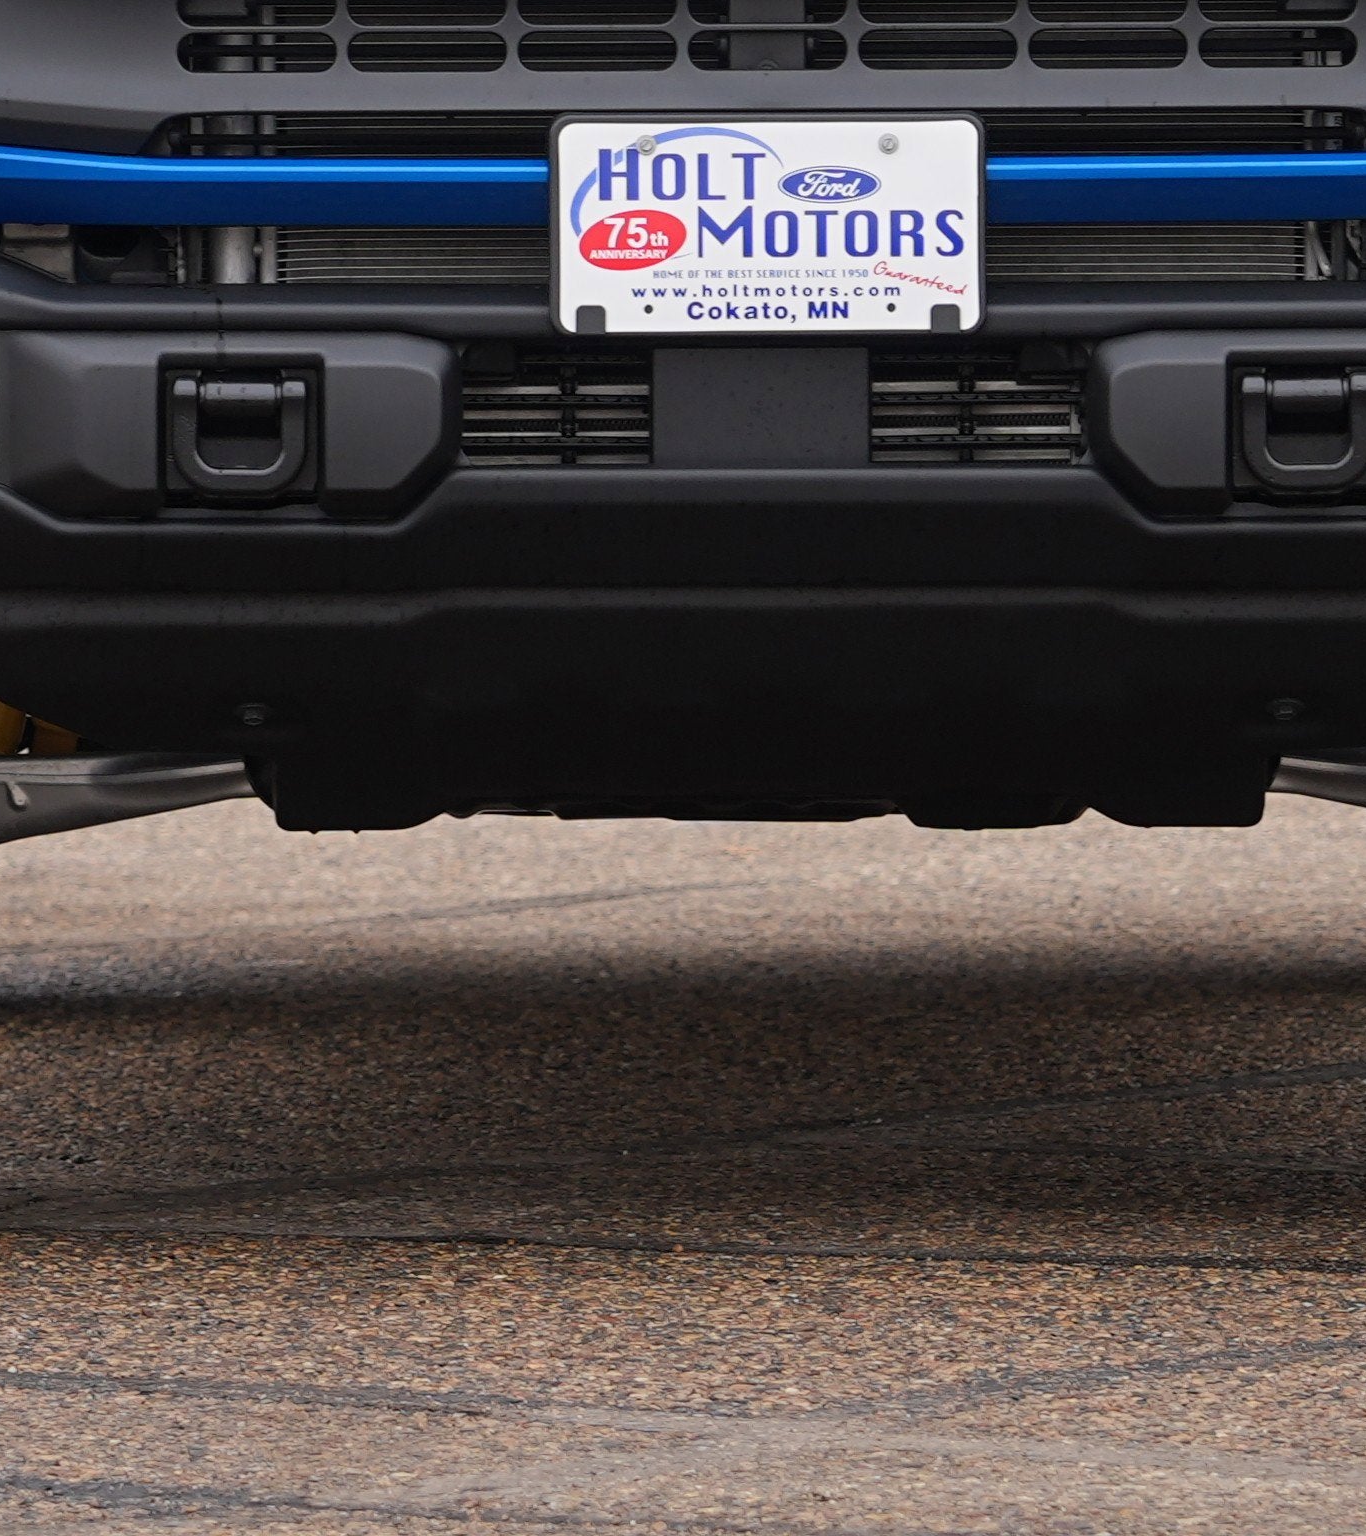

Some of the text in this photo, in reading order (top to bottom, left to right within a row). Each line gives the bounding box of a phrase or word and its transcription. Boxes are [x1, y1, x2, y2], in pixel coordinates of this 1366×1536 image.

[598, 148, 766, 201] HOLT
[797, 170, 862, 197] Ford
[603, 217, 669, 248] 75th
[697, 205, 965, 258] MOTORS
[589, 249, 669, 260] ANNIVERSARY
[653, 269, 869, 278] HOME OF THE BEST SERVICE SINCE 1950
[873, 260, 968, 296] Guaranteed
[631, 284, 901, 297] www.holtmotors.com
[687, 301, 849, 323] Cokato, MN
